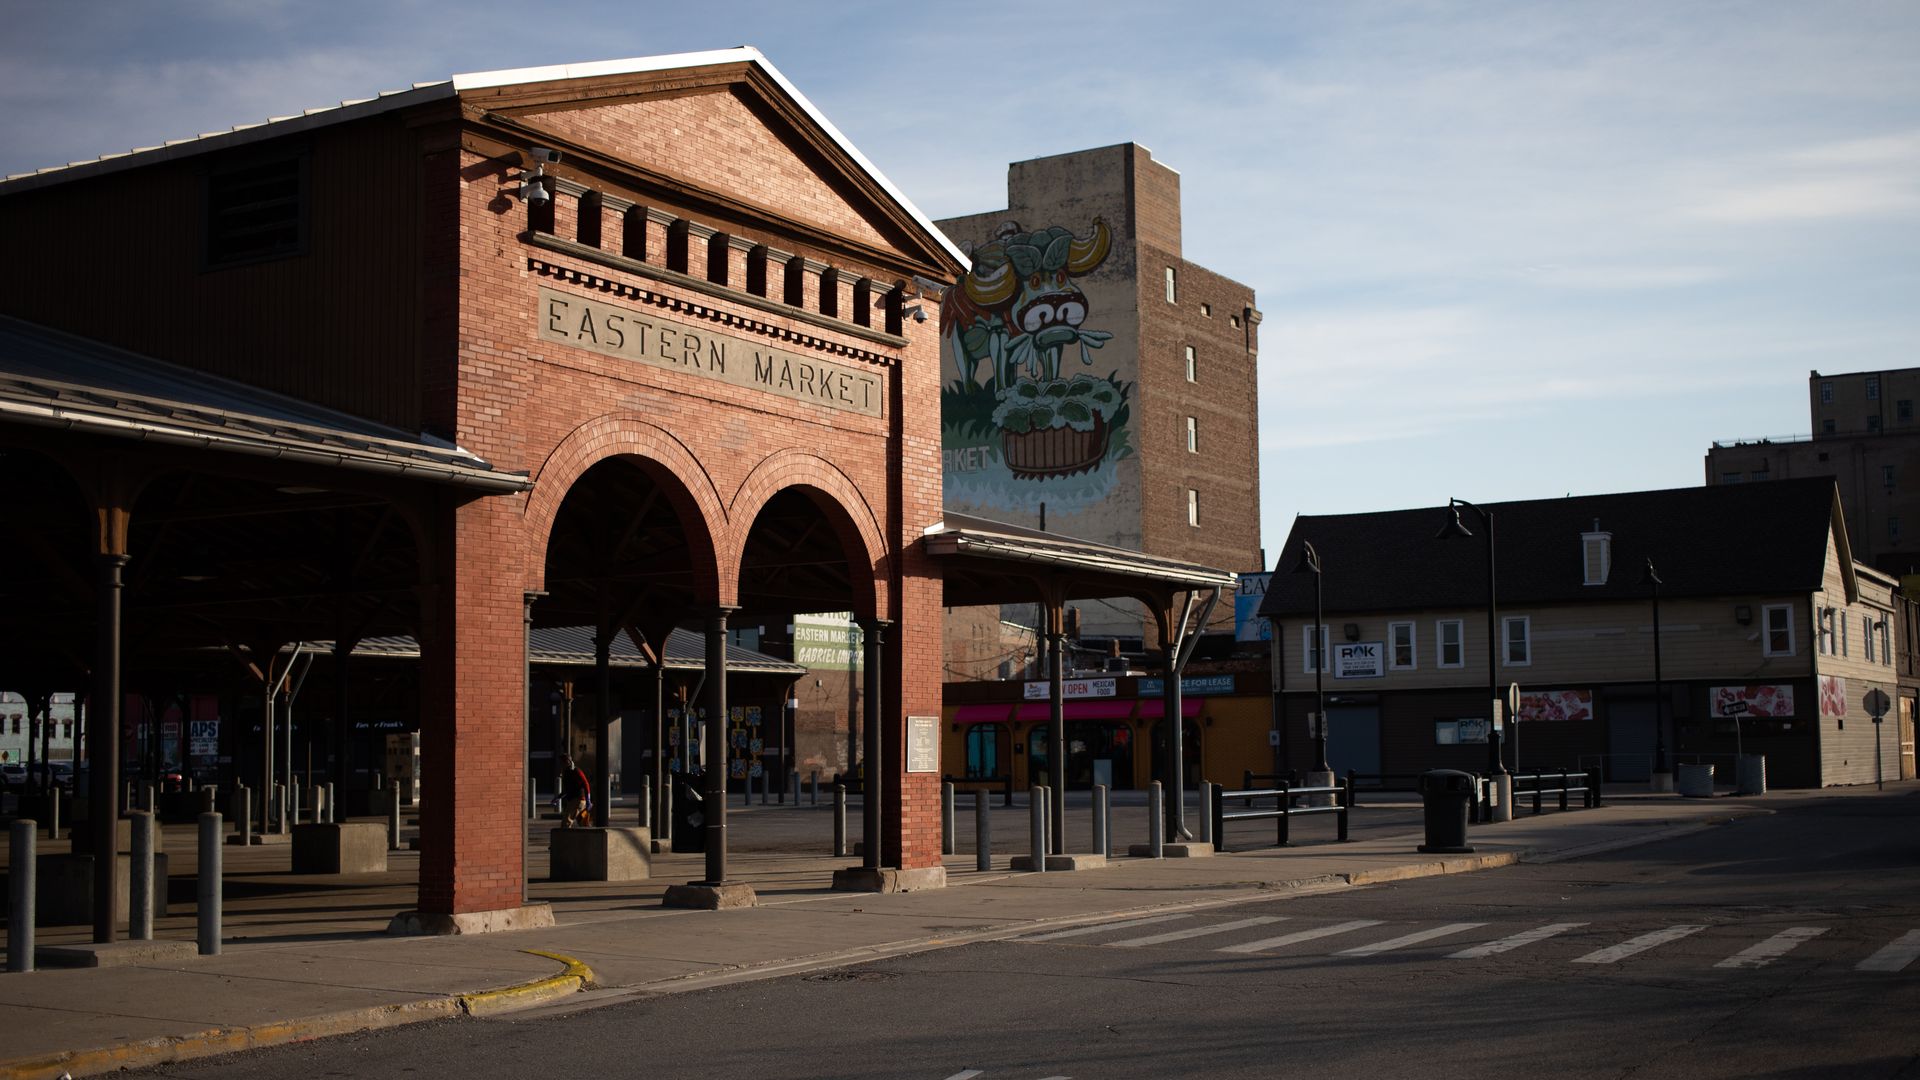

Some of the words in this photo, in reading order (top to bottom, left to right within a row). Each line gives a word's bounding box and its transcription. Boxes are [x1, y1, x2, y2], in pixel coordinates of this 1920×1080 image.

[549, 298, 726, 374] EASTERN
[754, 351, 874, 408] MARKET
[795, 627, 829, 642] EASTERN
[831, 630, 860, 645] MARKET
[798, 647, 836, 663] GABRIEL
[1068, 683, 1088, 695] OPEN
[1093, 680, 1115, 689] MEXICAN
[1191, 679, 1207, 688] FOR
[1208, 678, 1231, 687] LEASE
[1097, 687, 1111, 696] FOOD
